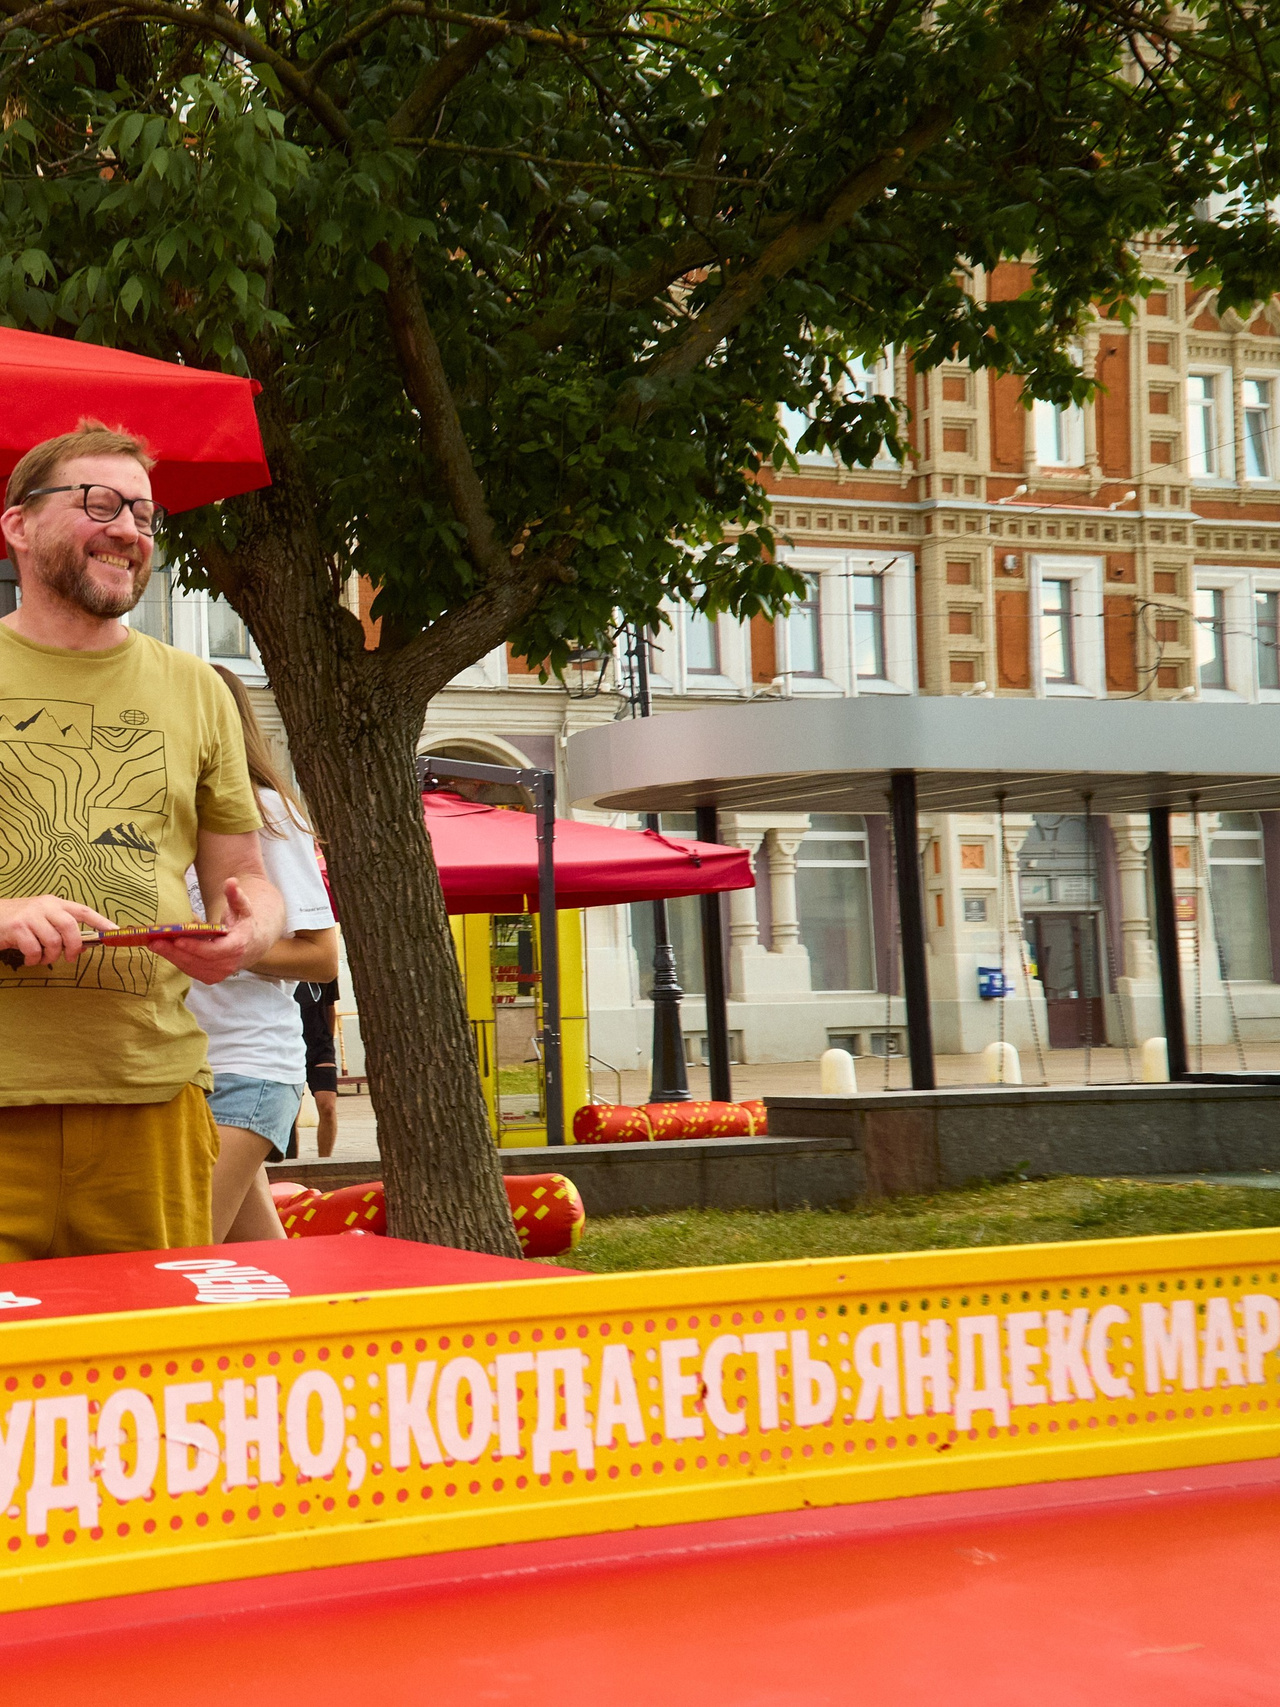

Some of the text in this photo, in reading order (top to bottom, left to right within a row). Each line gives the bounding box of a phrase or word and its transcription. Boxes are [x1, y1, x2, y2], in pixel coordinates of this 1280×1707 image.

[154, 1258, 291, 1304] ОЧЕНЬ
[386, 1344, 646, 1474] КОГДА
[660, 1330, 837, 1439] ЕСТЬ
[853, 1304, 1129, 1431] ЯНДЕКС
[1141, 1293, 1280, 1392] МАР
